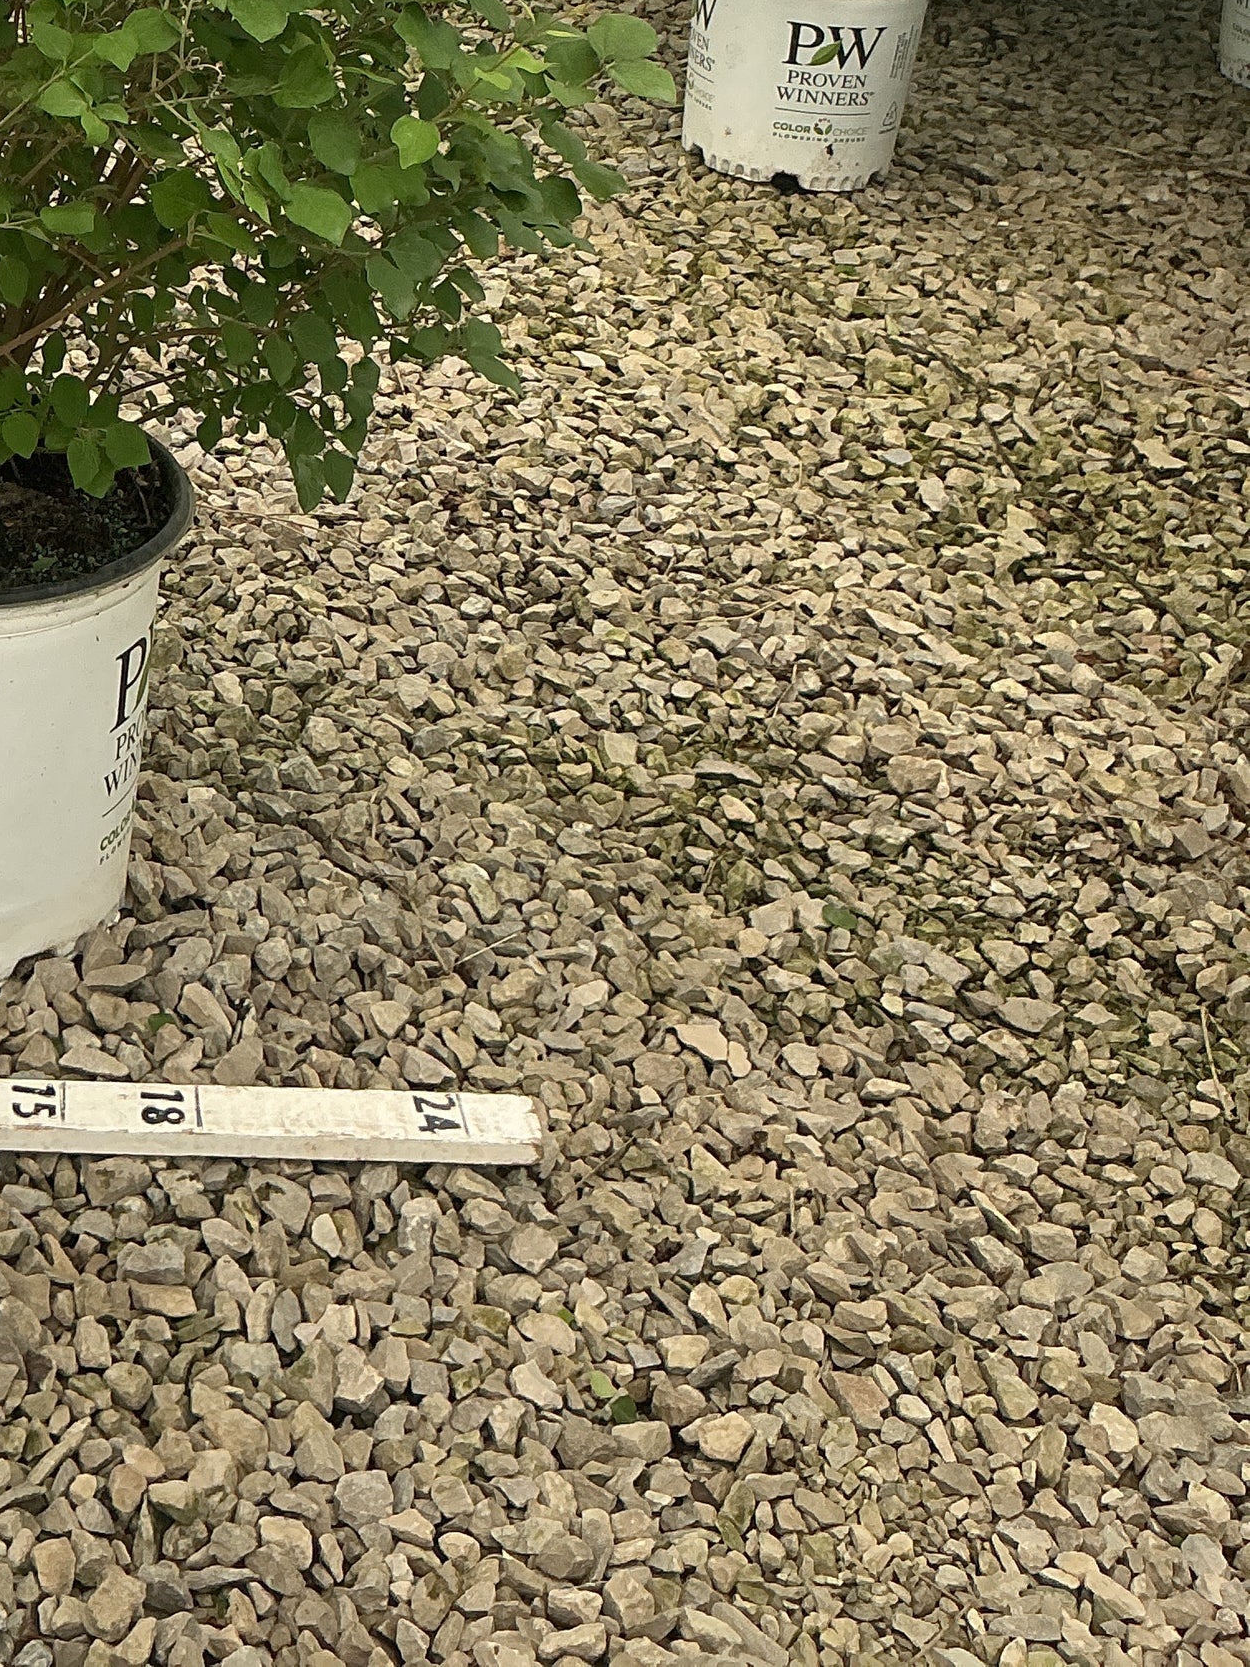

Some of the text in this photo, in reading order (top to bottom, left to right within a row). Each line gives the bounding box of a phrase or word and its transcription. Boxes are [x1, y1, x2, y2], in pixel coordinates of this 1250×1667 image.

[782, 21, 888, 70] PW
[787, 69, 867, 88] PROVEN
[773, 122, 811, 133] COLOR
[11, 1083, 56, 1120] 15
[140, 1089, 185, 1126] 18
[411, 1094, 461, 1133] 24
